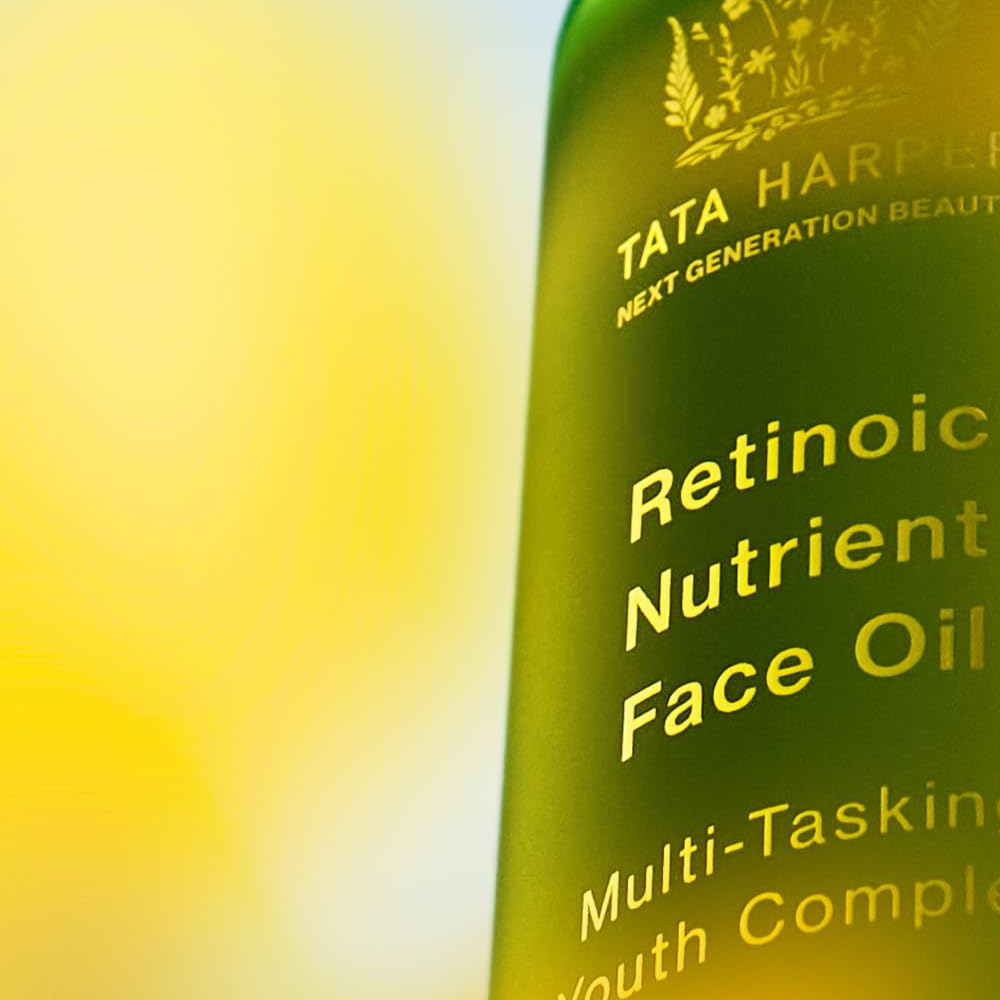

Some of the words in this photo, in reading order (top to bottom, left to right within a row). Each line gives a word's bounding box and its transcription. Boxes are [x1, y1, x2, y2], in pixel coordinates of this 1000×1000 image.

[616, 188, 730, 281] TATA
[616, 270, 679, 330] NEXT
[684, 203, 879, 284] GENERATION
[630, 393, 990, 544] Retinoic
[625, 501, 989, 652] Nutrient
[620, 645, 815, 763] Face
[854, 605, 986, 678] Oil
